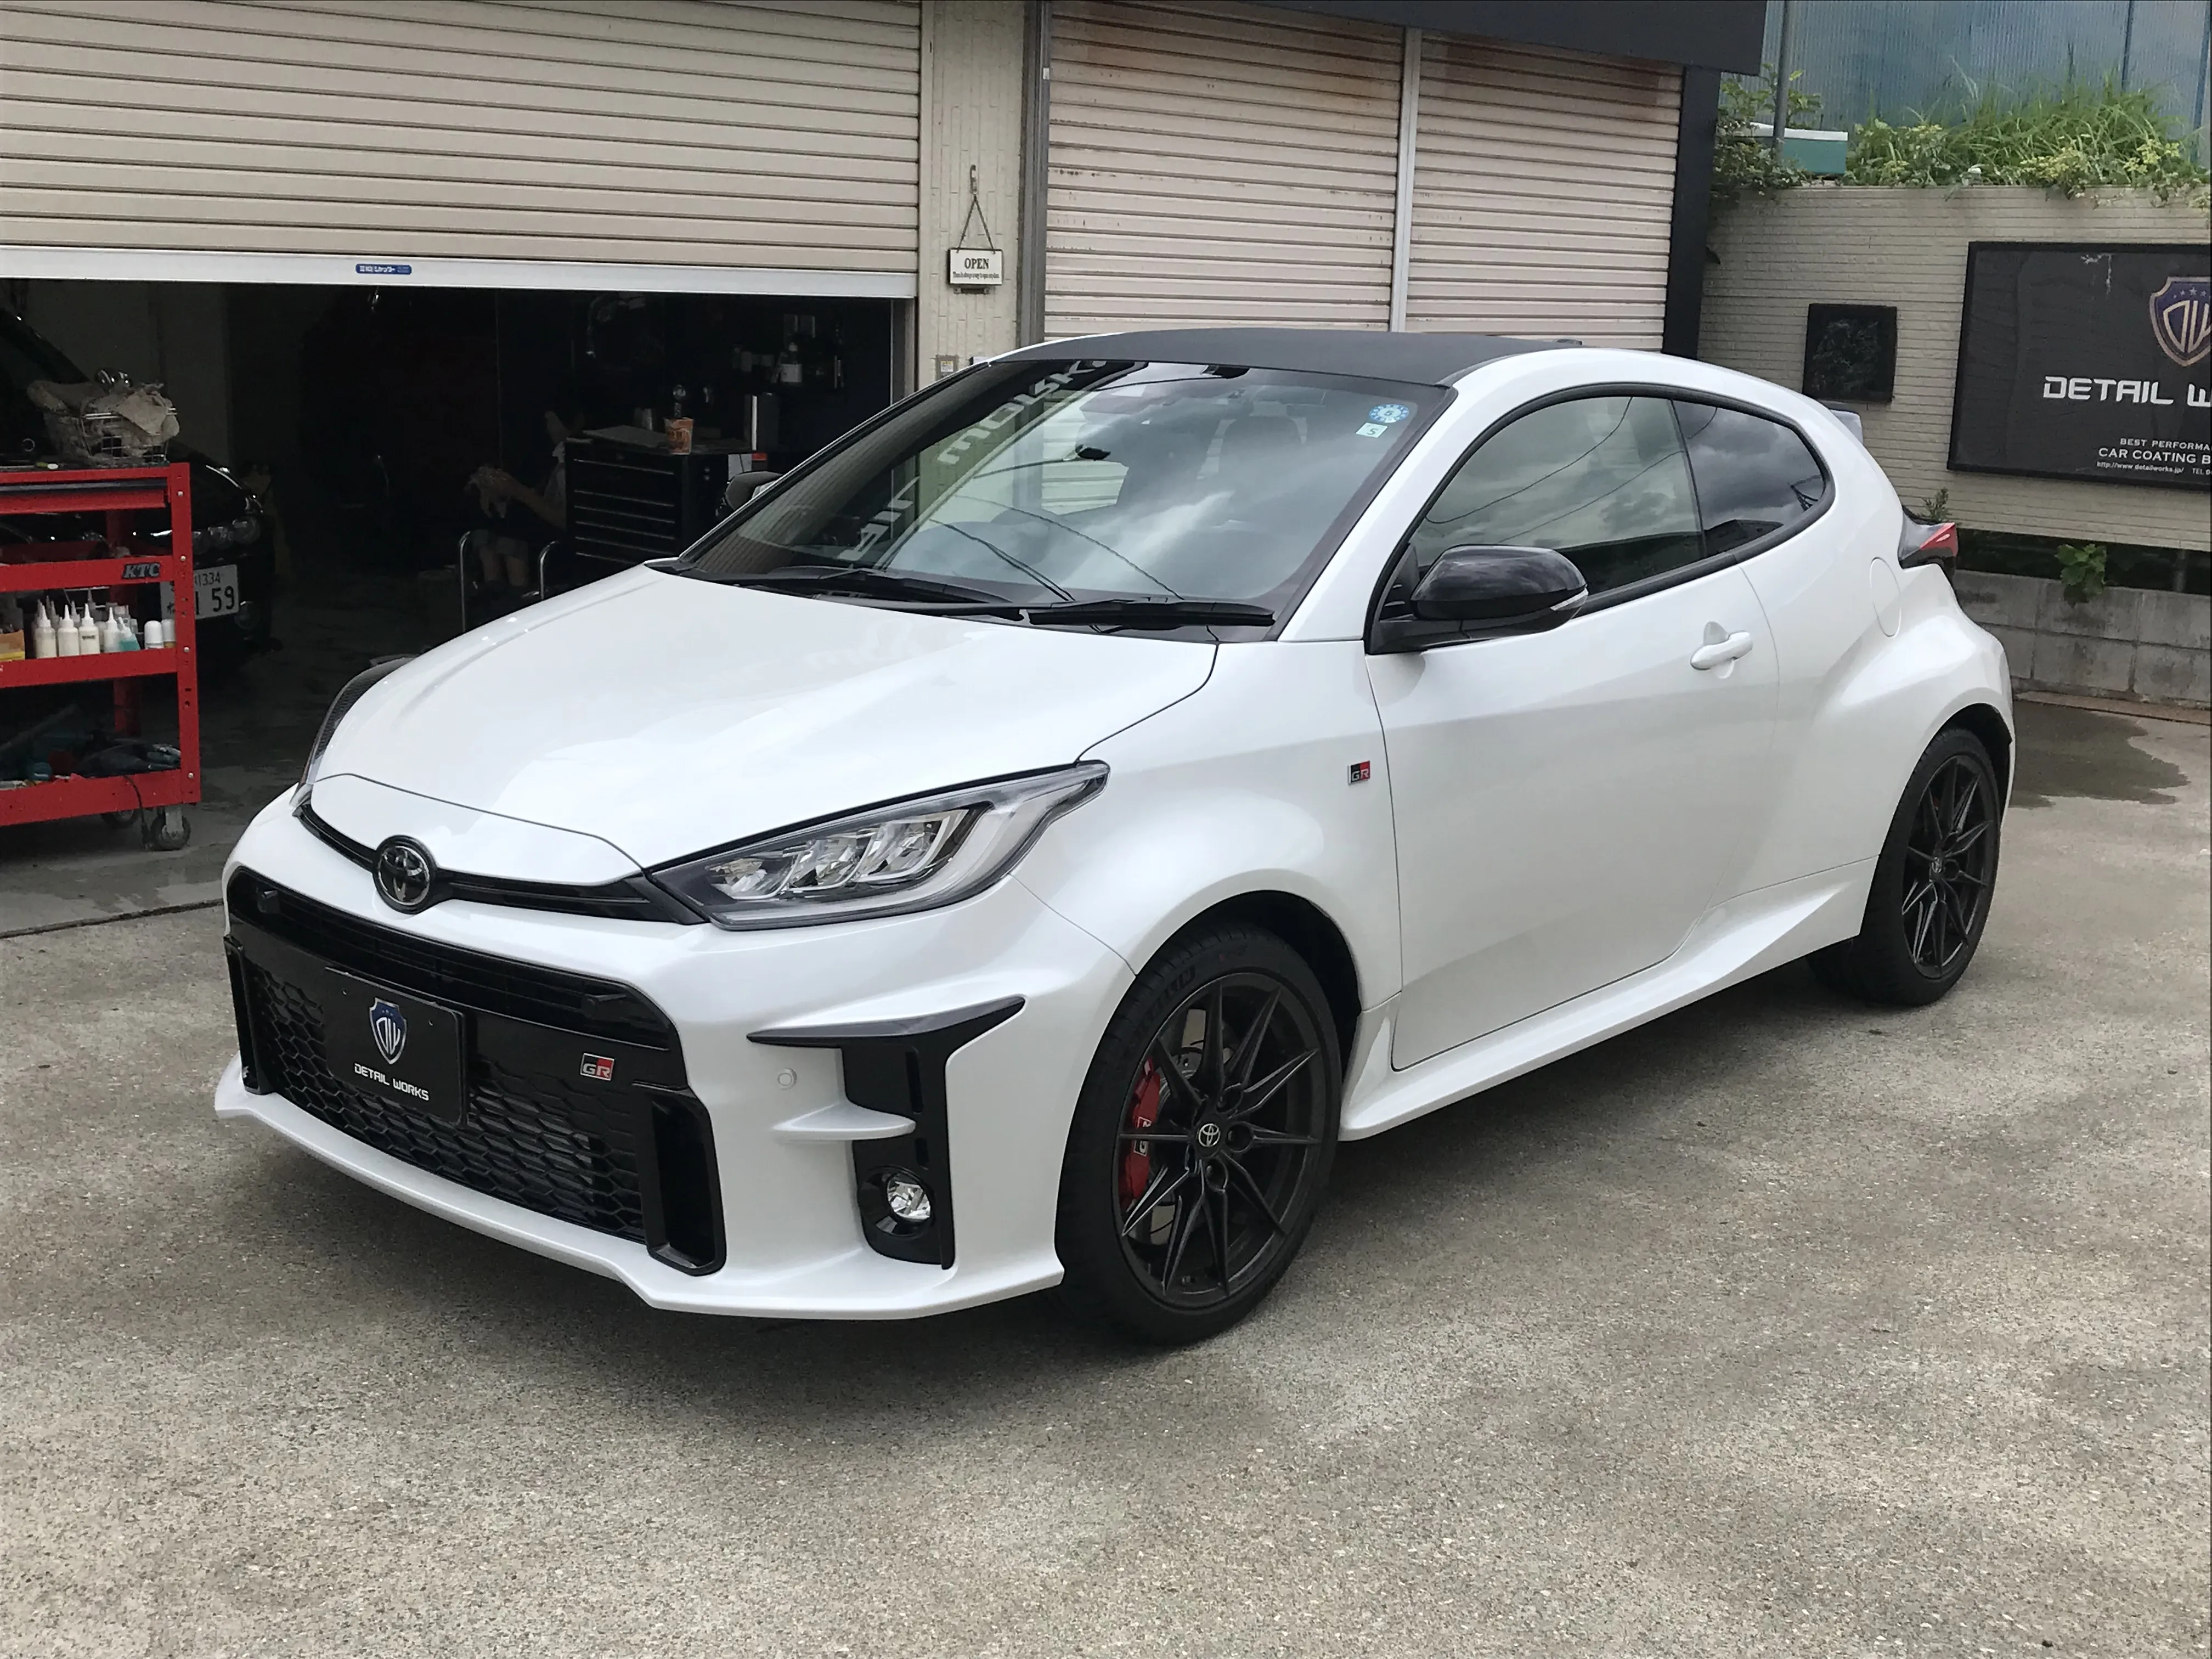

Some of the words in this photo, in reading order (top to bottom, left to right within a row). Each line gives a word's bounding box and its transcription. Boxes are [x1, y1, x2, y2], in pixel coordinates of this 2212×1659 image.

[964, 257, 989, 269] OPEN
[2043, 376, 2174, 405] DETAIL
[2120, 438, 2147, 447] BEST
[2098, 447, 2128, 459] CAR
[2132, 450, 2196, 464] COATING
[123, 563, 160, 578] KTC
[212, 585, 235, 612] 59
[1351, 768, 1369, 782] GR
[583, 1063, 610, 1078] GR
[354, 1063, 390, 1086] DETAIL
[392, 1078, 429, 1101] WORKS
